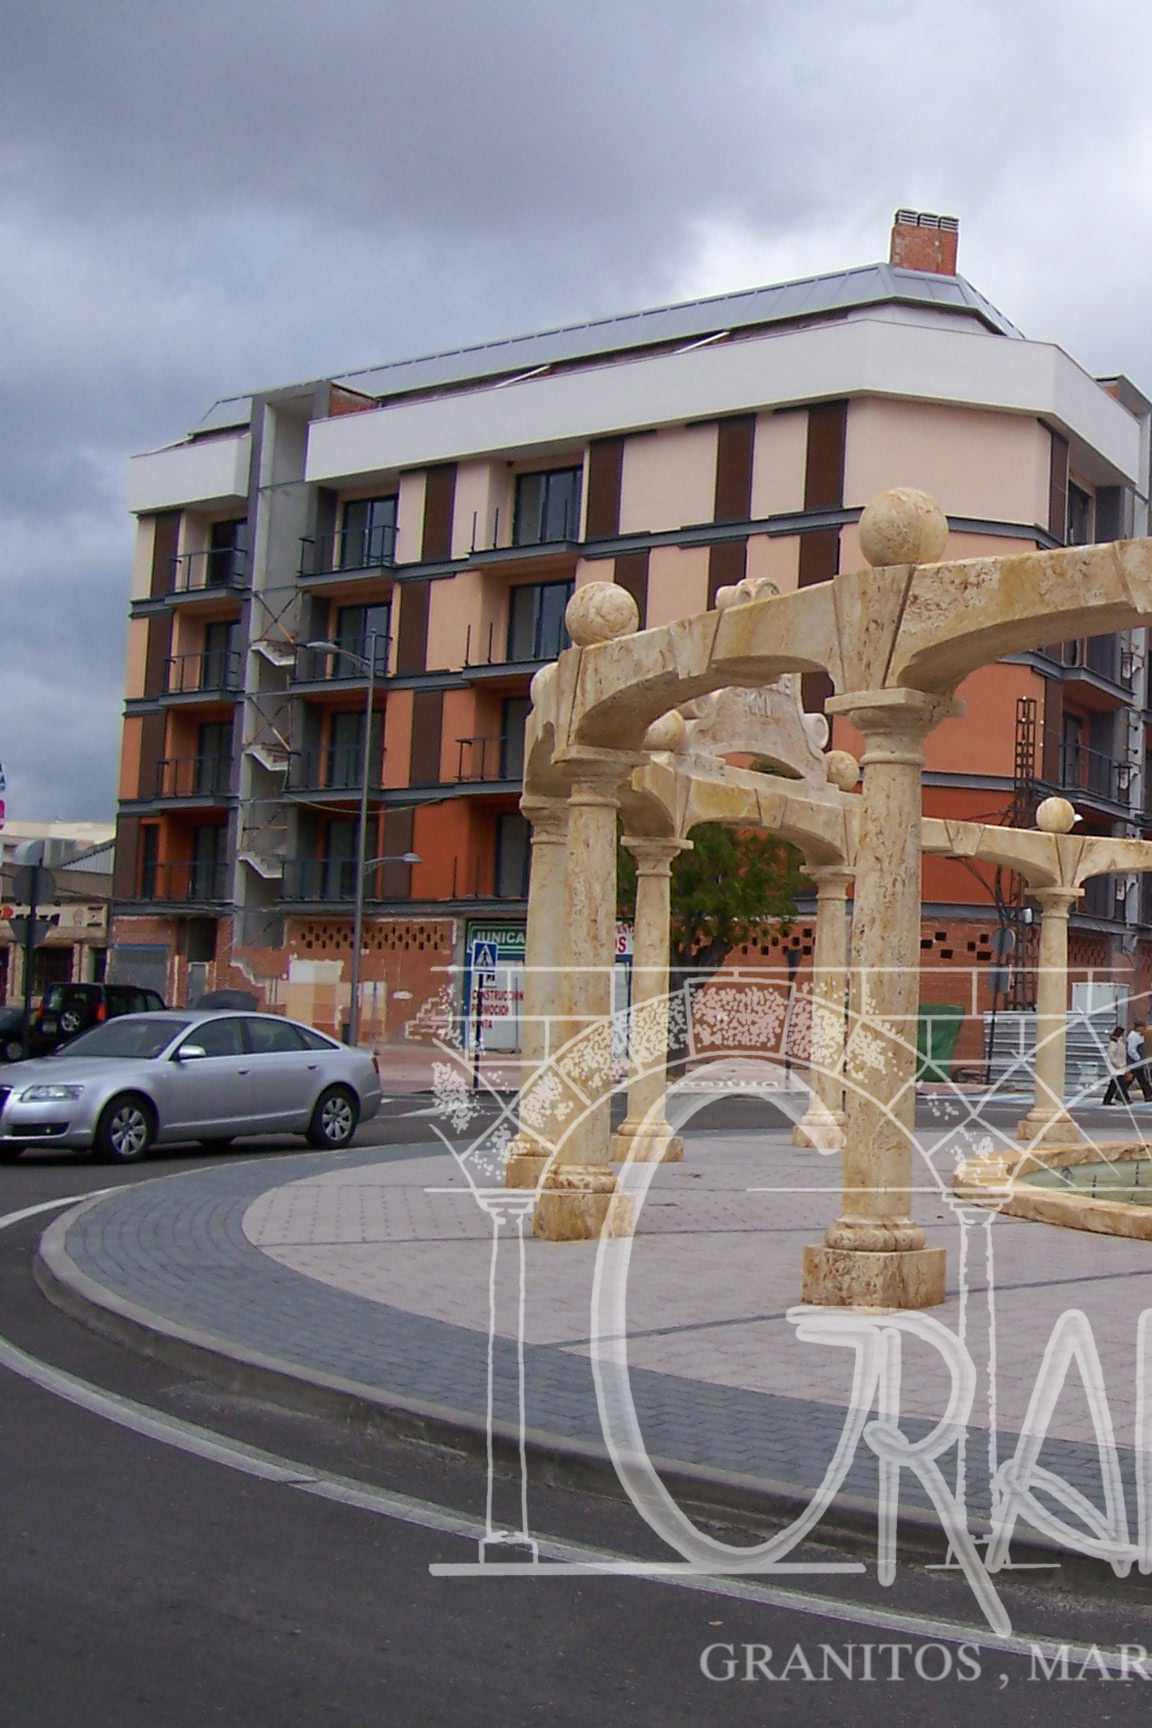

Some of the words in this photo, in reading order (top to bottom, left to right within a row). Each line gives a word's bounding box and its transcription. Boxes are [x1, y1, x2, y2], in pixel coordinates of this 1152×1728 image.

[472, 989, 525, 1002] CNSTRUCION
[471, 1003, 509, 1016] POMOCION
[471, 1019, 493, 1029] VNTA
